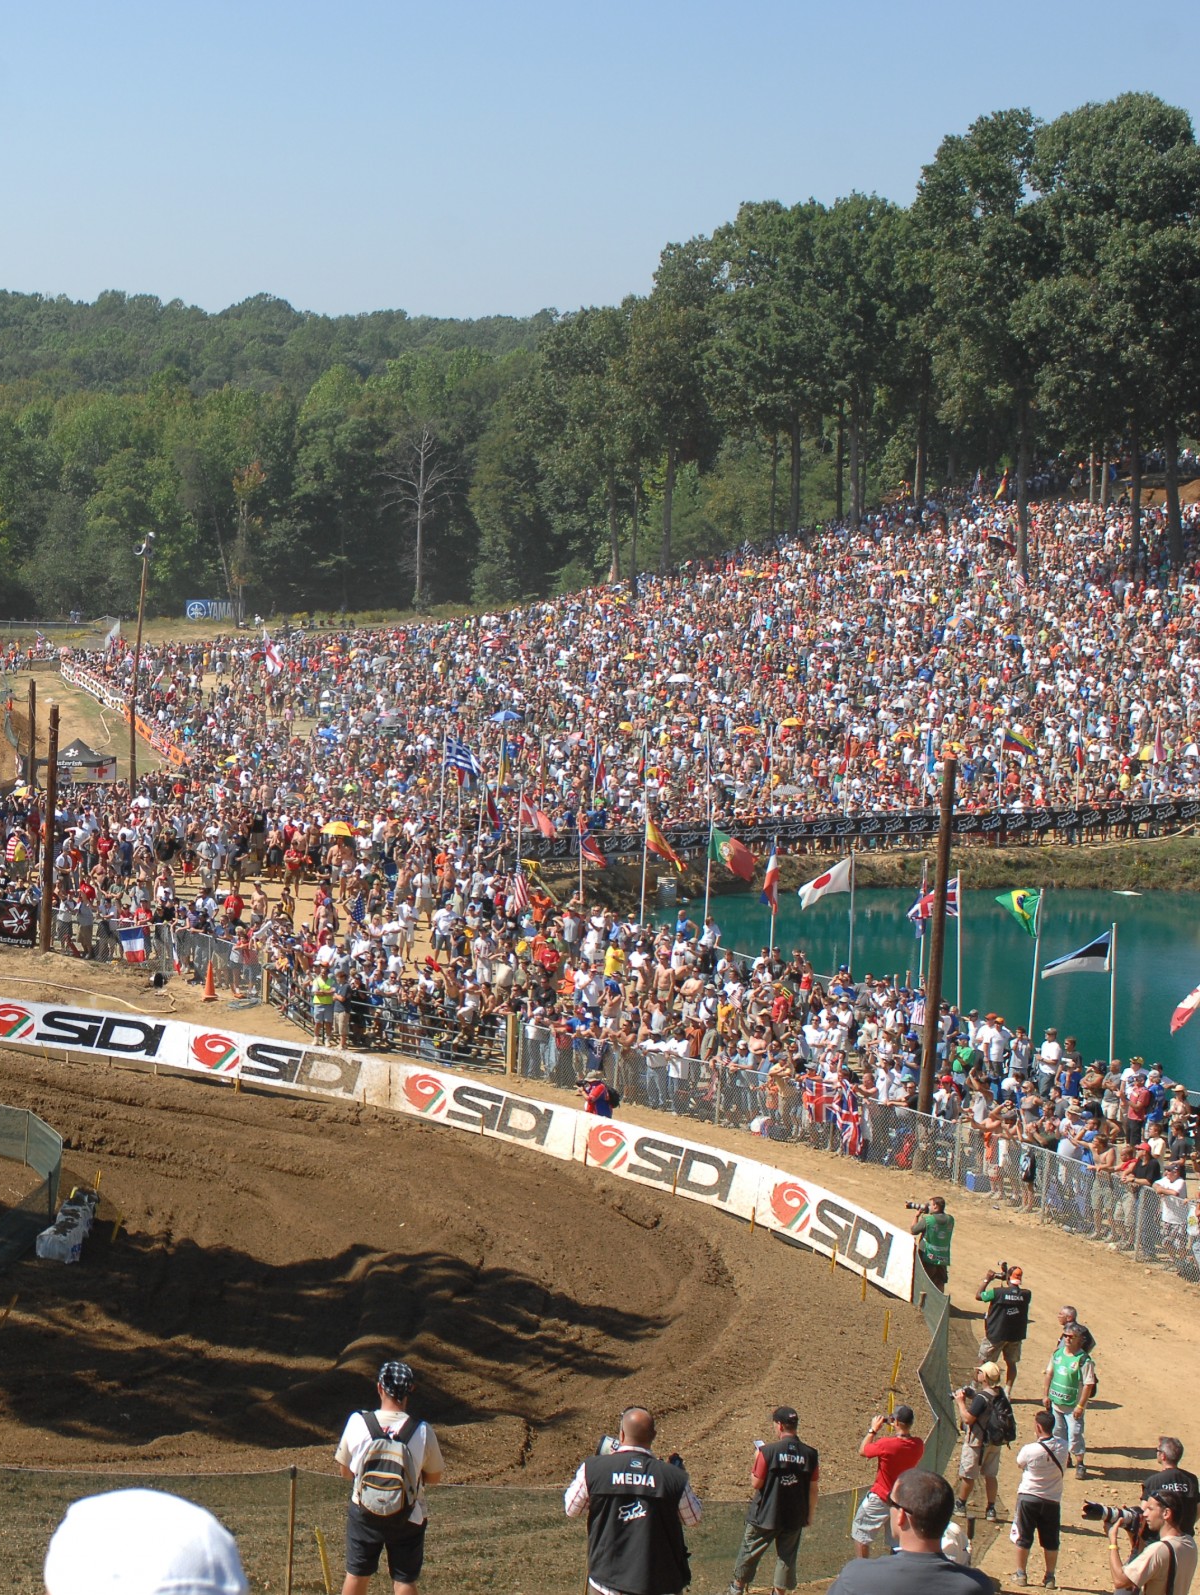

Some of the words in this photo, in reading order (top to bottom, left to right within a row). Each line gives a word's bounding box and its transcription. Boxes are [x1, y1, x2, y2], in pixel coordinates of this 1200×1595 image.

[35, 1010, 166, 1056] SIDI
[240, 1042, 362, 1094] SIDI
[446, 1085, 554, 1146] SIDI
[626, 1136, 737, 1203] SIDI
[808, 1197, 894, 1278] SIDI
[612, 1472, 656, 1488] MEDIA
[779, 1453, 806, 1464] MEDIA
